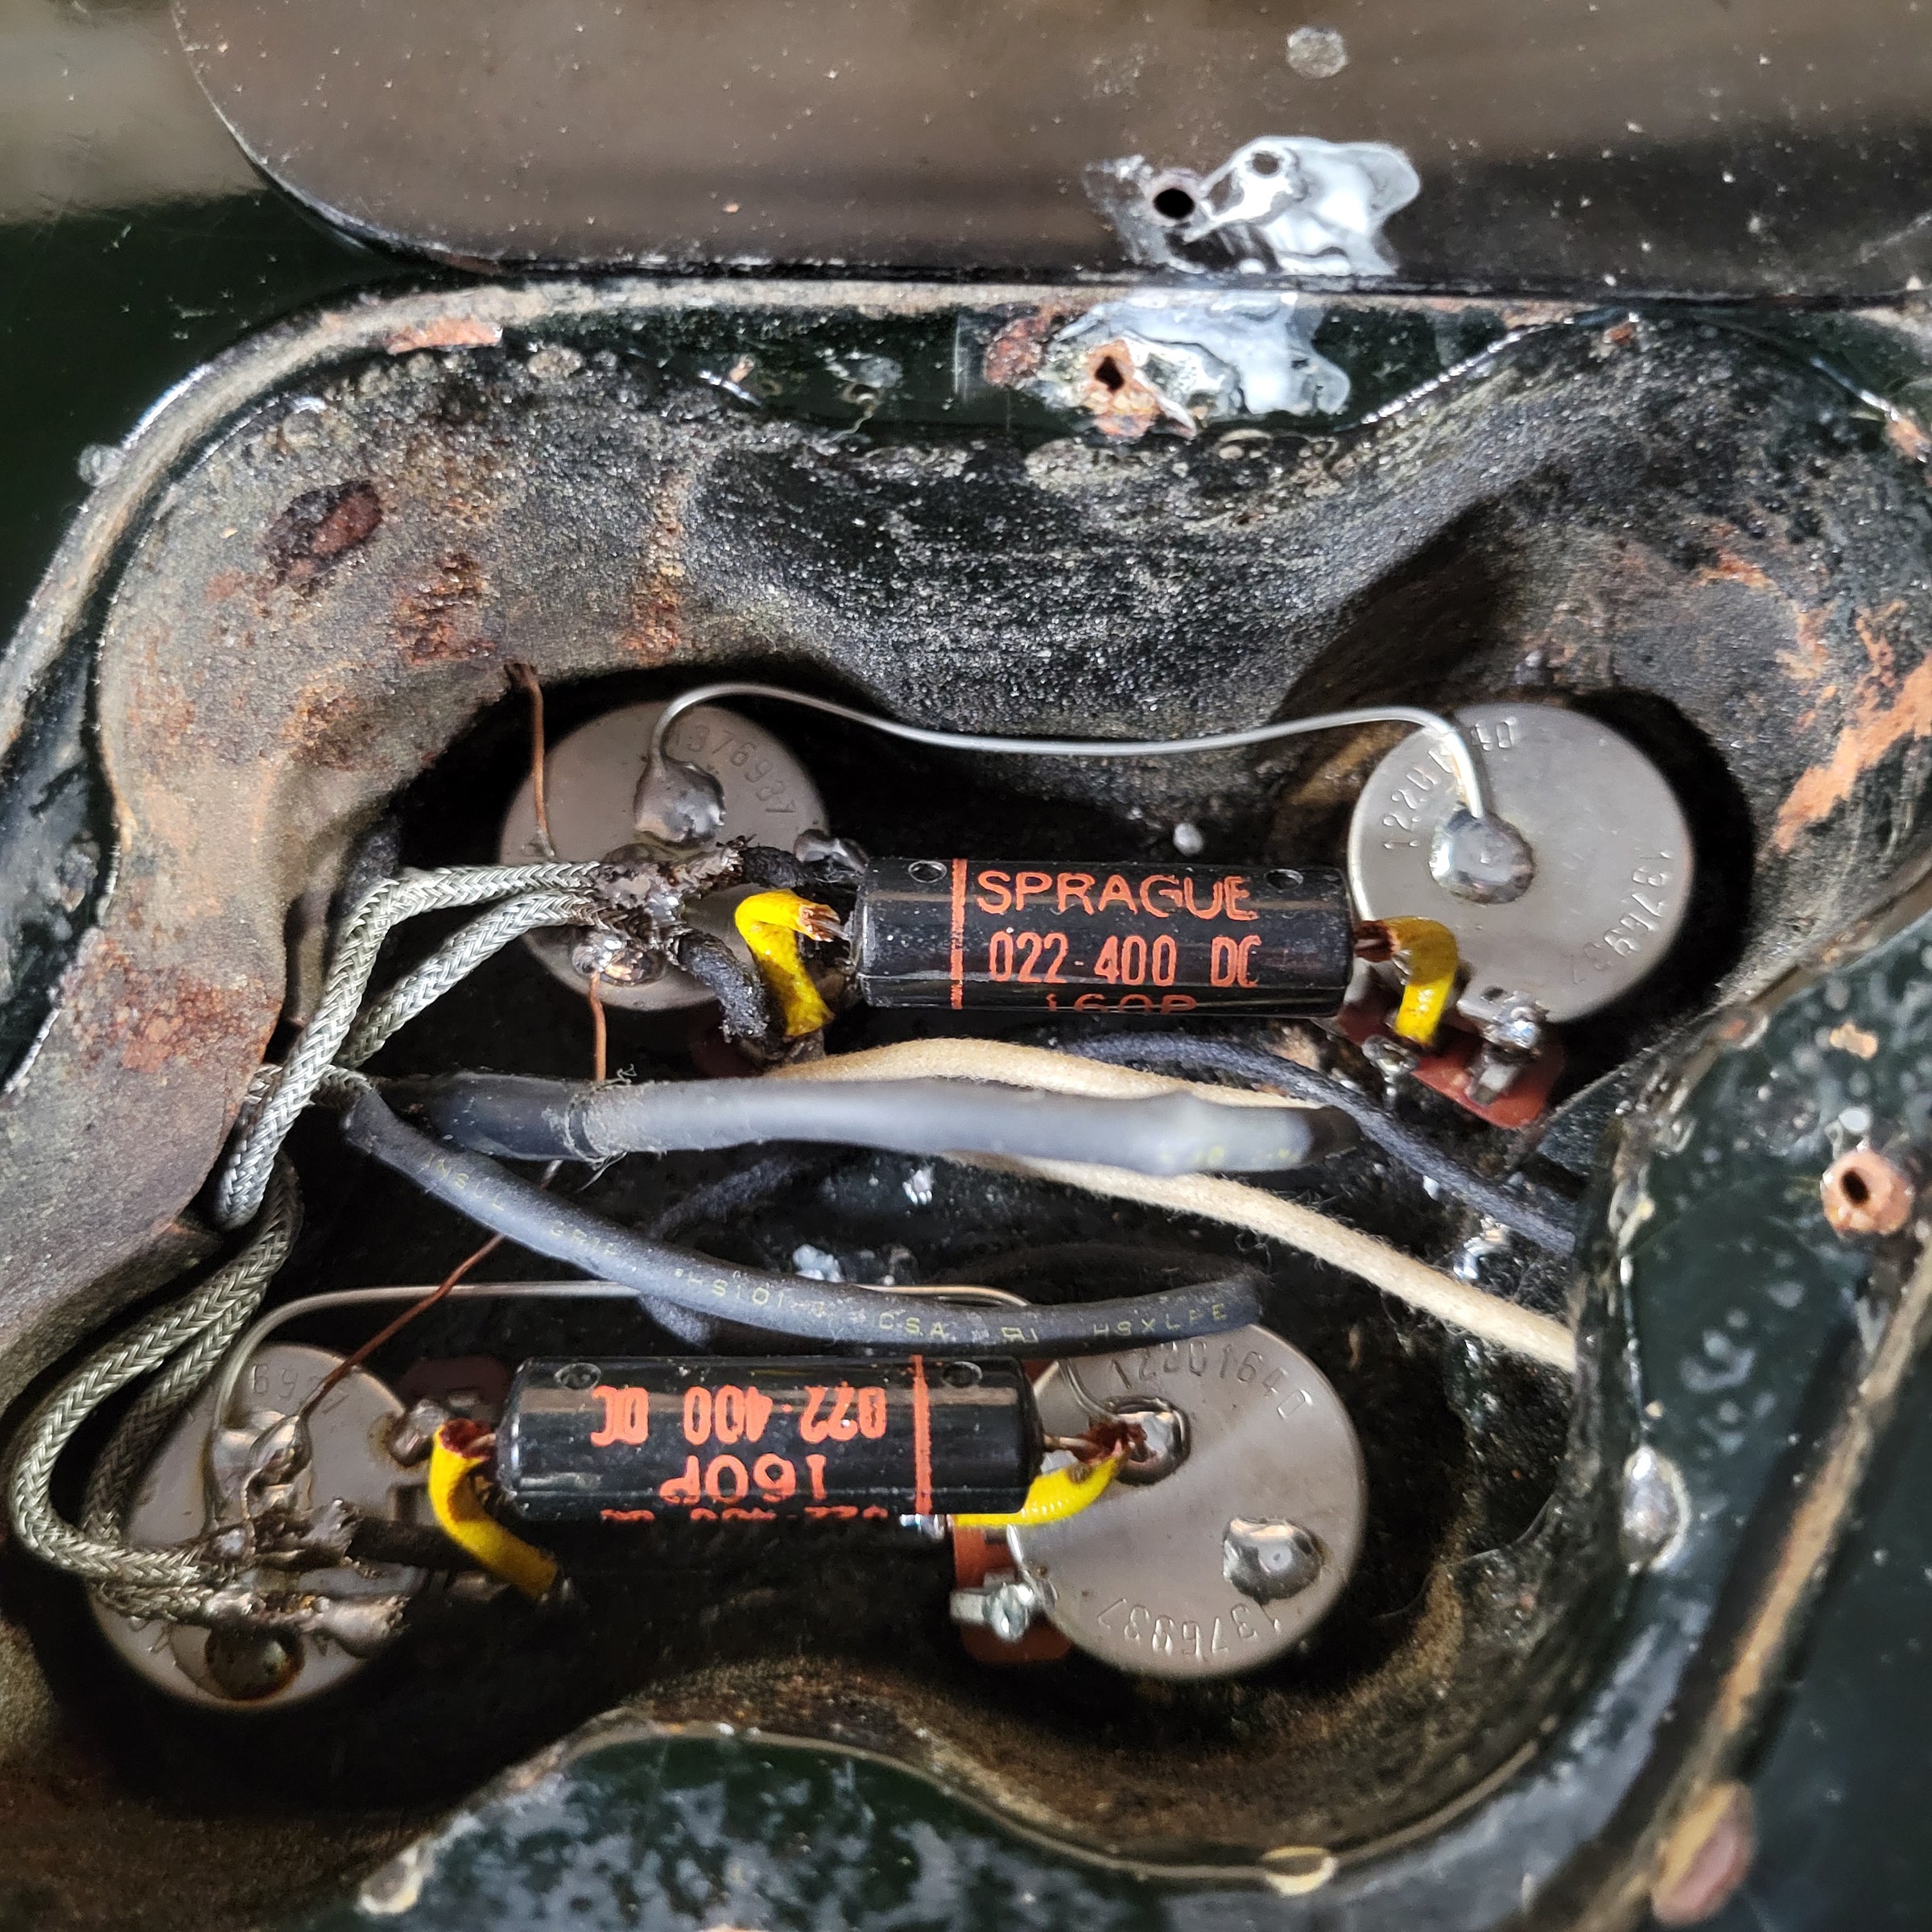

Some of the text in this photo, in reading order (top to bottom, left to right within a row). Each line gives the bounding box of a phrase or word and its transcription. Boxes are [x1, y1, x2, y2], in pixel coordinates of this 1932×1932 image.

[976, 870, 1260, 921] SPRAGUE
[1210, 935, 1262, 989] DC
[877, 1311, 947, 1342] CSA
[590, 1385, 649, 1446] DC
[658, 1452, 828, 1504] 160P
